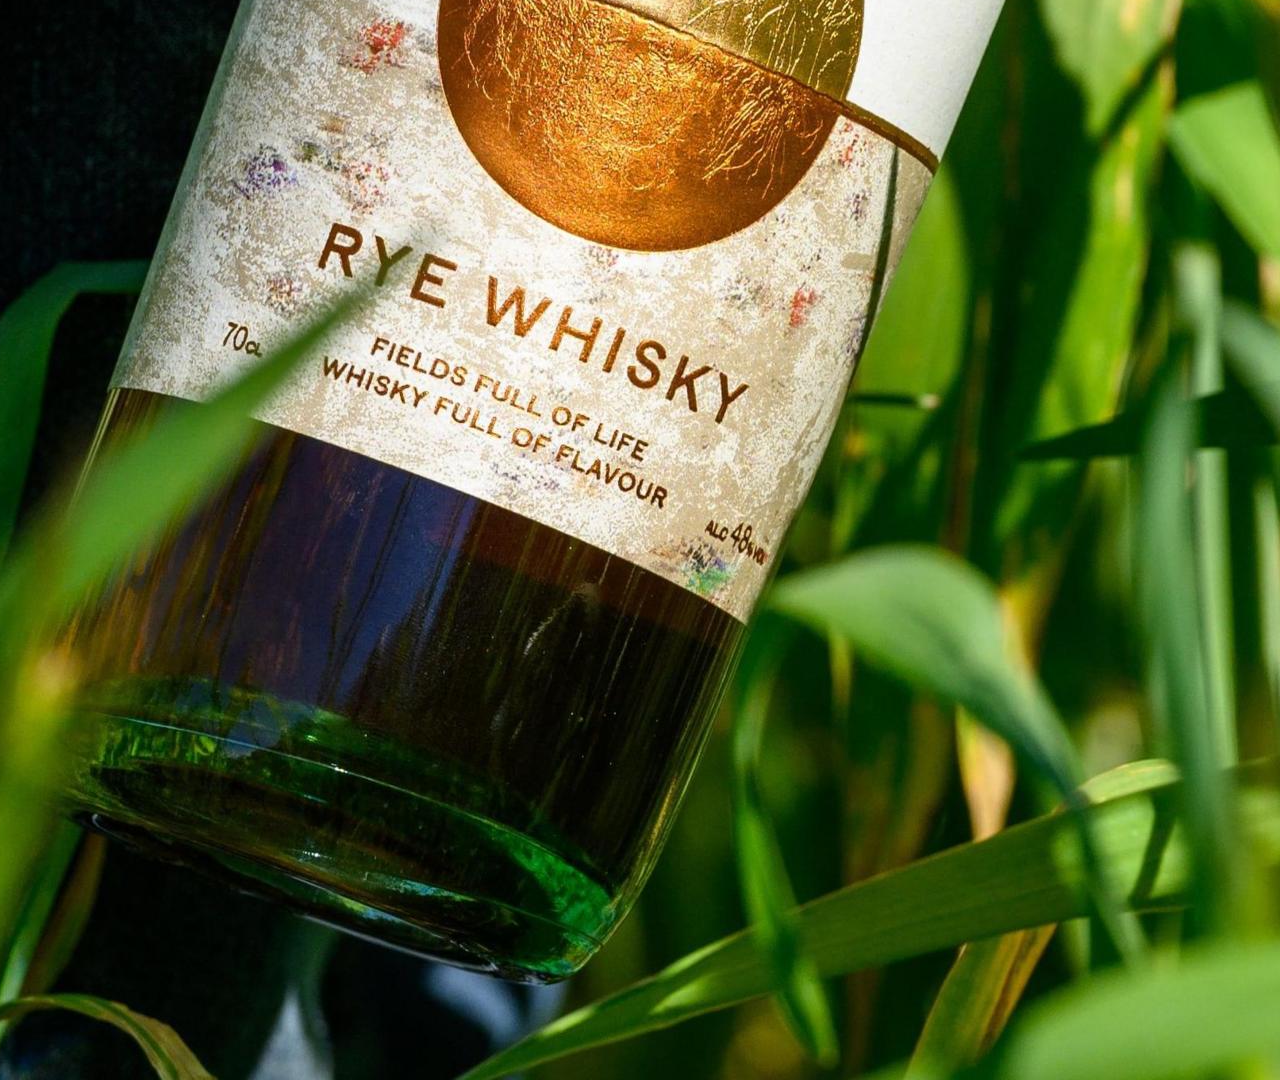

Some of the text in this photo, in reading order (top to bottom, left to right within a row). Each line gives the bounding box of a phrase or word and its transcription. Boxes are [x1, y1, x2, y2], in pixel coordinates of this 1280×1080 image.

[318, 223, 750, 424] RYE WHISKY
[370, 336, 649, 463] FIELDS FULL OF LIFE
[322, 355, 669, 509] WHISKY FULL OF FLAVOUR
